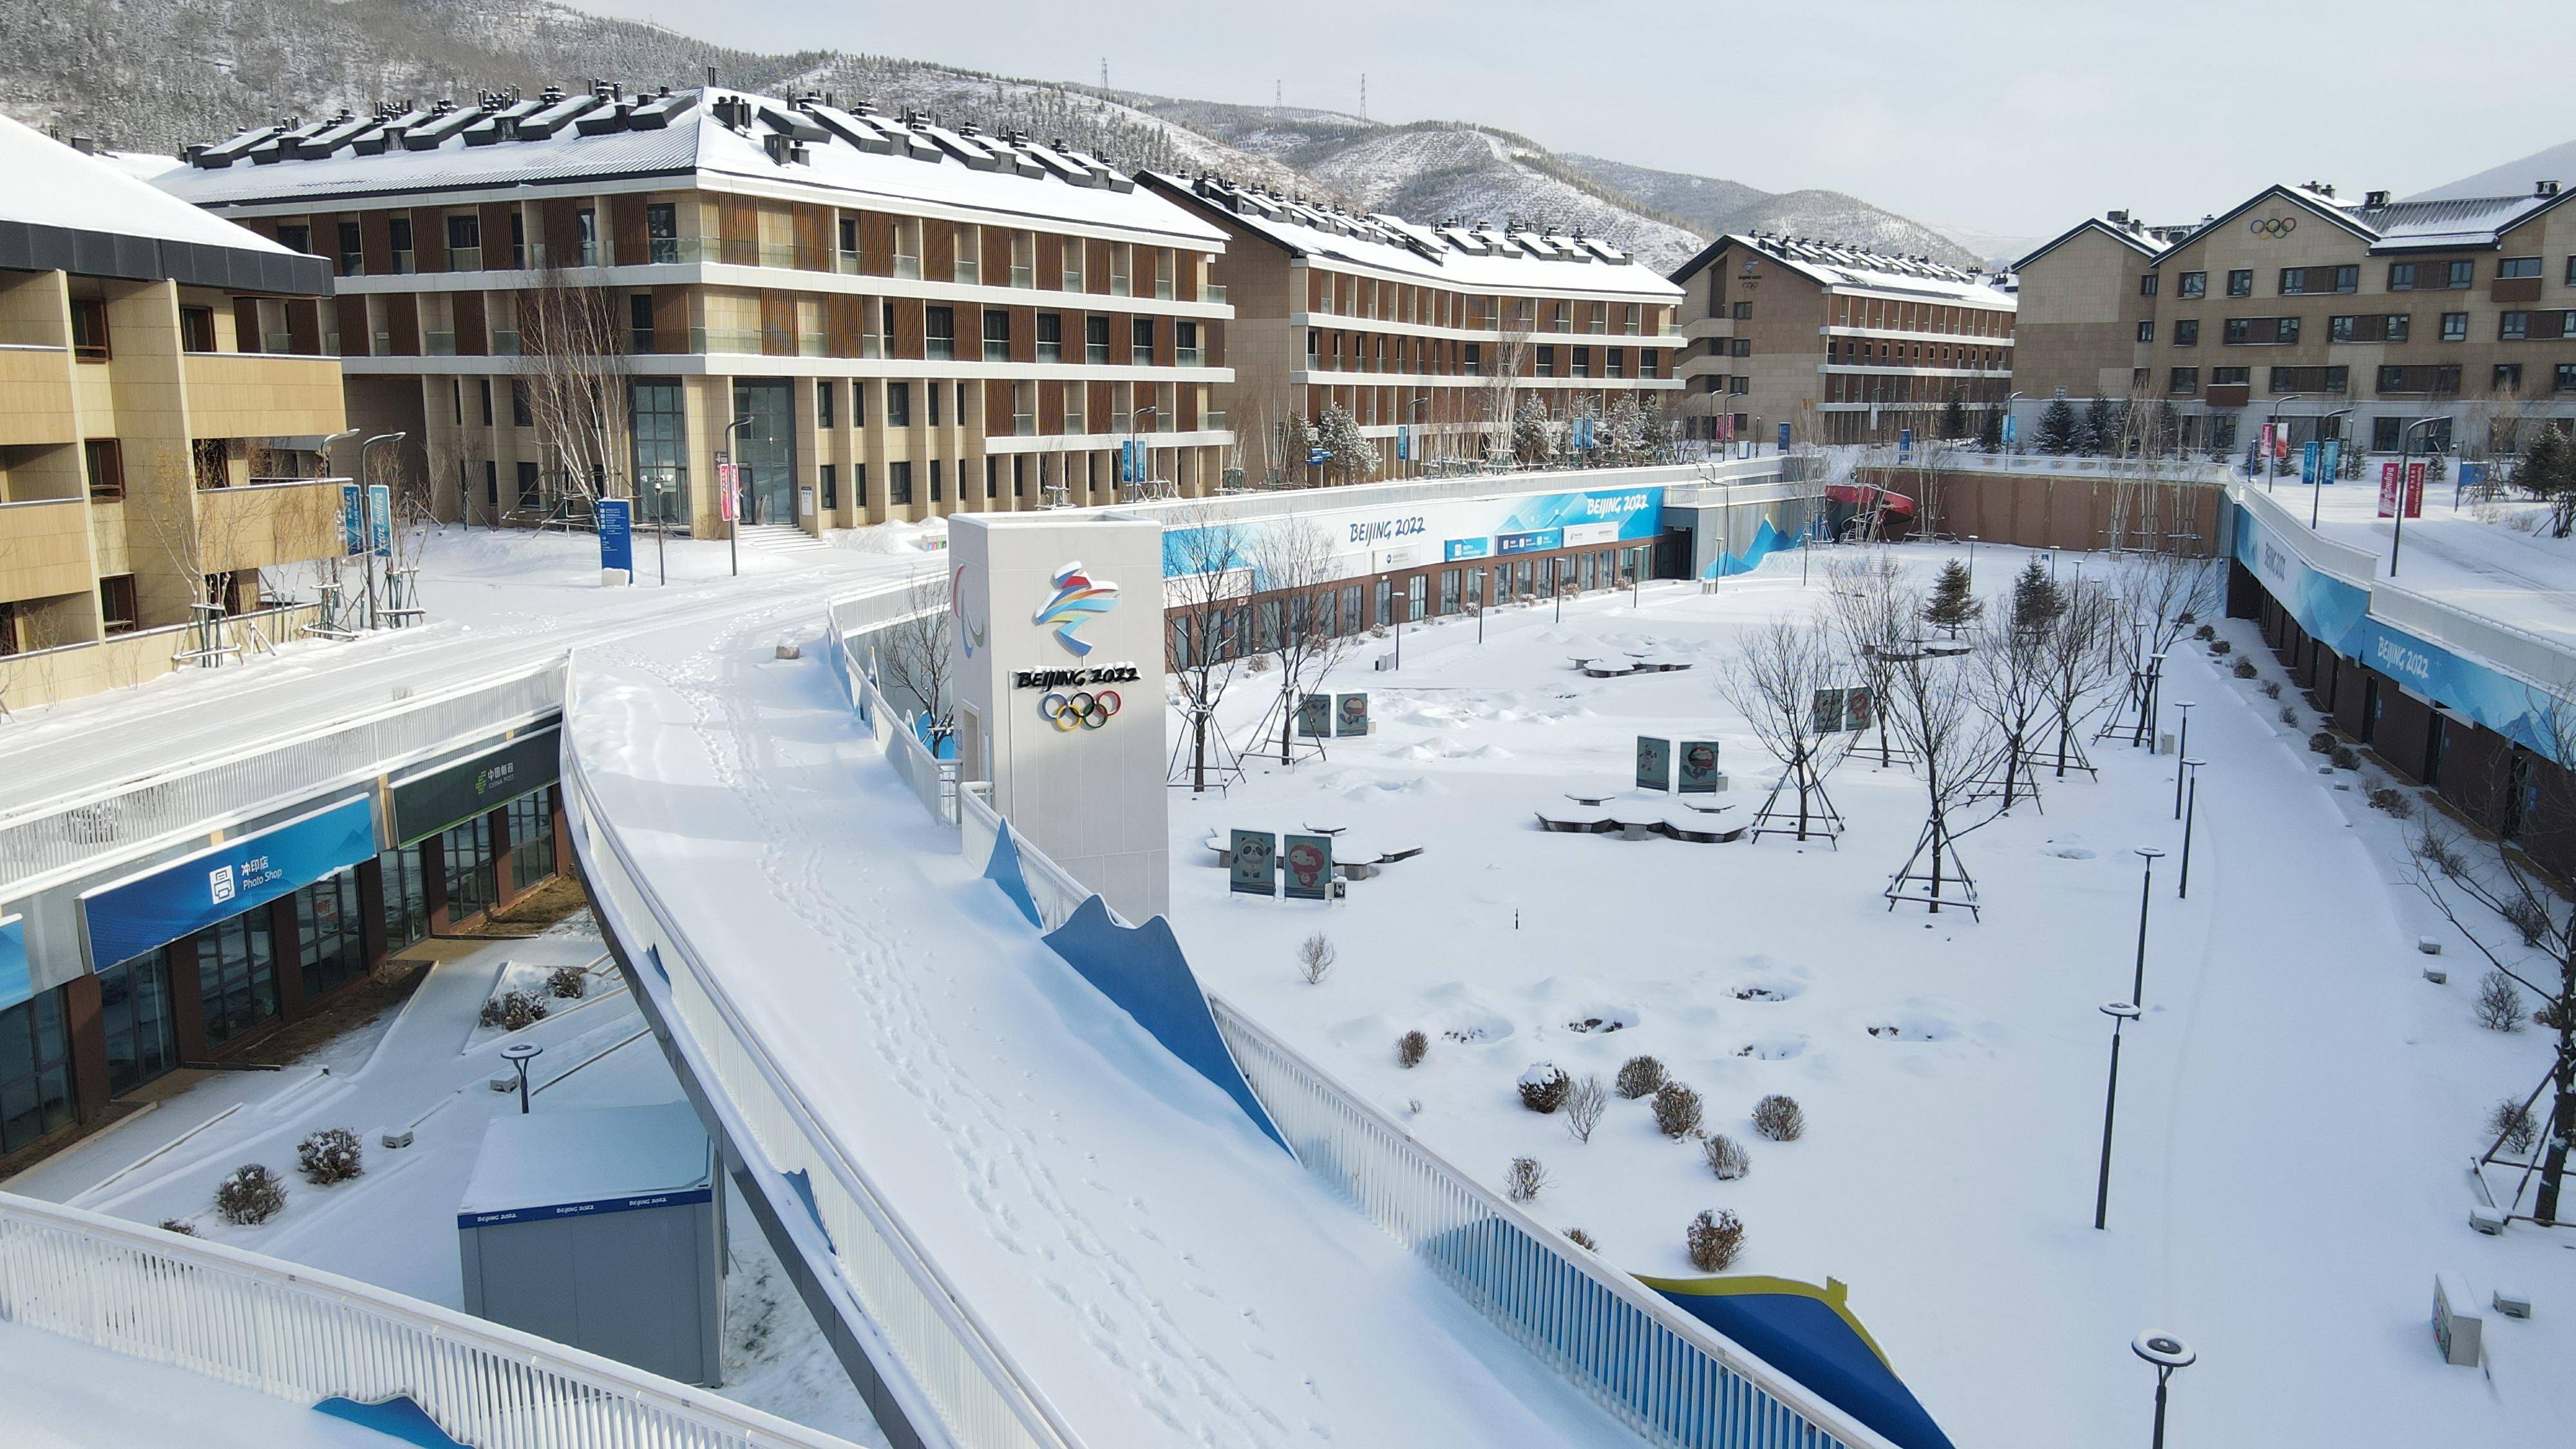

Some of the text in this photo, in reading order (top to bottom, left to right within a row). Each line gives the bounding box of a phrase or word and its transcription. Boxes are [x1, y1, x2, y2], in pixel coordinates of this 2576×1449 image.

[375, 493, 385, 526] BEIJING
[1587, 495, 1649, 519] BEIJING 2022
[1350, 516, 1426, 547] BEIJING 2022
[2378, 636, 2429, 679] BEIJING 2022
[1017, 667, 1141, 692] BEIJING 2022
[241, 855, 269, 876] 冲印店
[243, 869, 283, 891] Photo Shop
